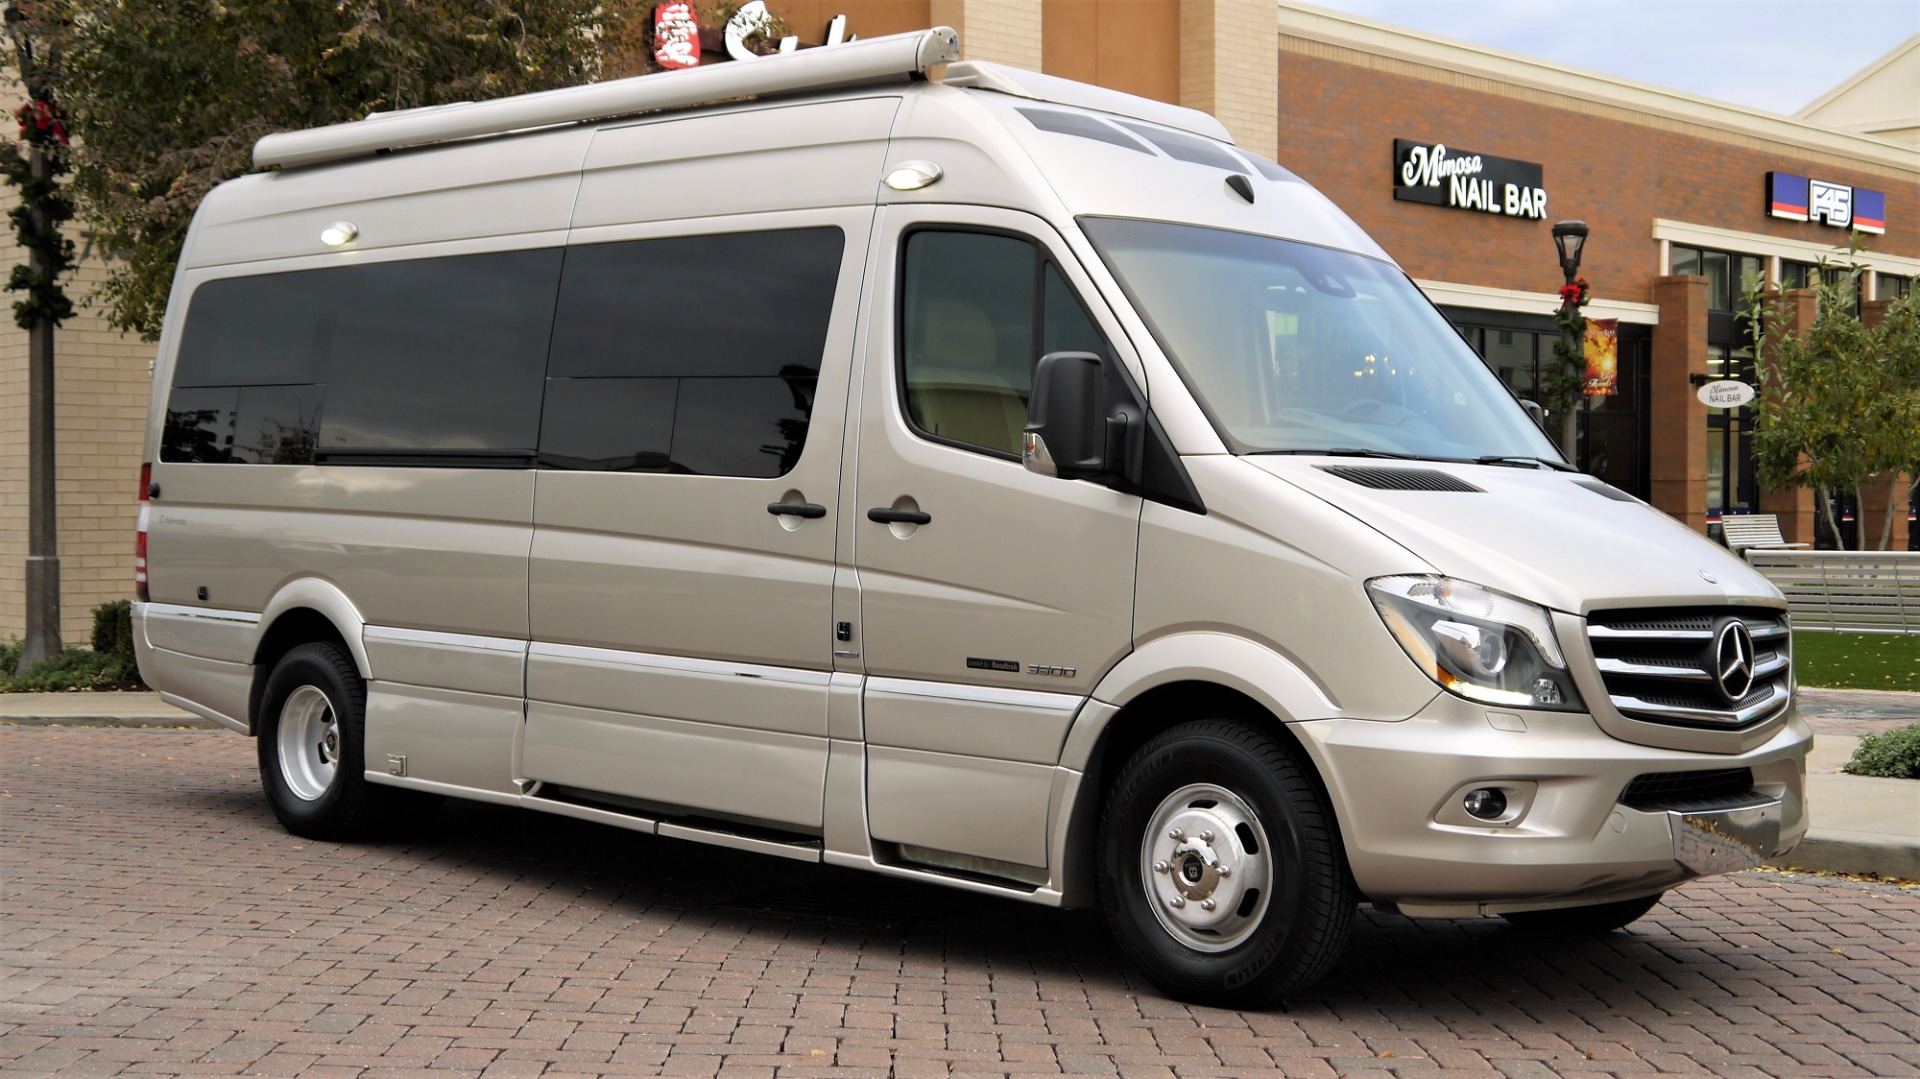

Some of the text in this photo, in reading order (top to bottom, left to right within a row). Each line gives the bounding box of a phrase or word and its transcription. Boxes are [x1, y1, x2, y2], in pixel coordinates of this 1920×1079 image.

[1402, 144, 1482, 187] Mimosa
[1451, 175, 1547, 219] NAIL BAR
[1709, 385, 1739, 395] Mimosa
[1709, 393, 1742, 403] NAIL BAR
[1227, 927, 1285, 987] MICHELIN
